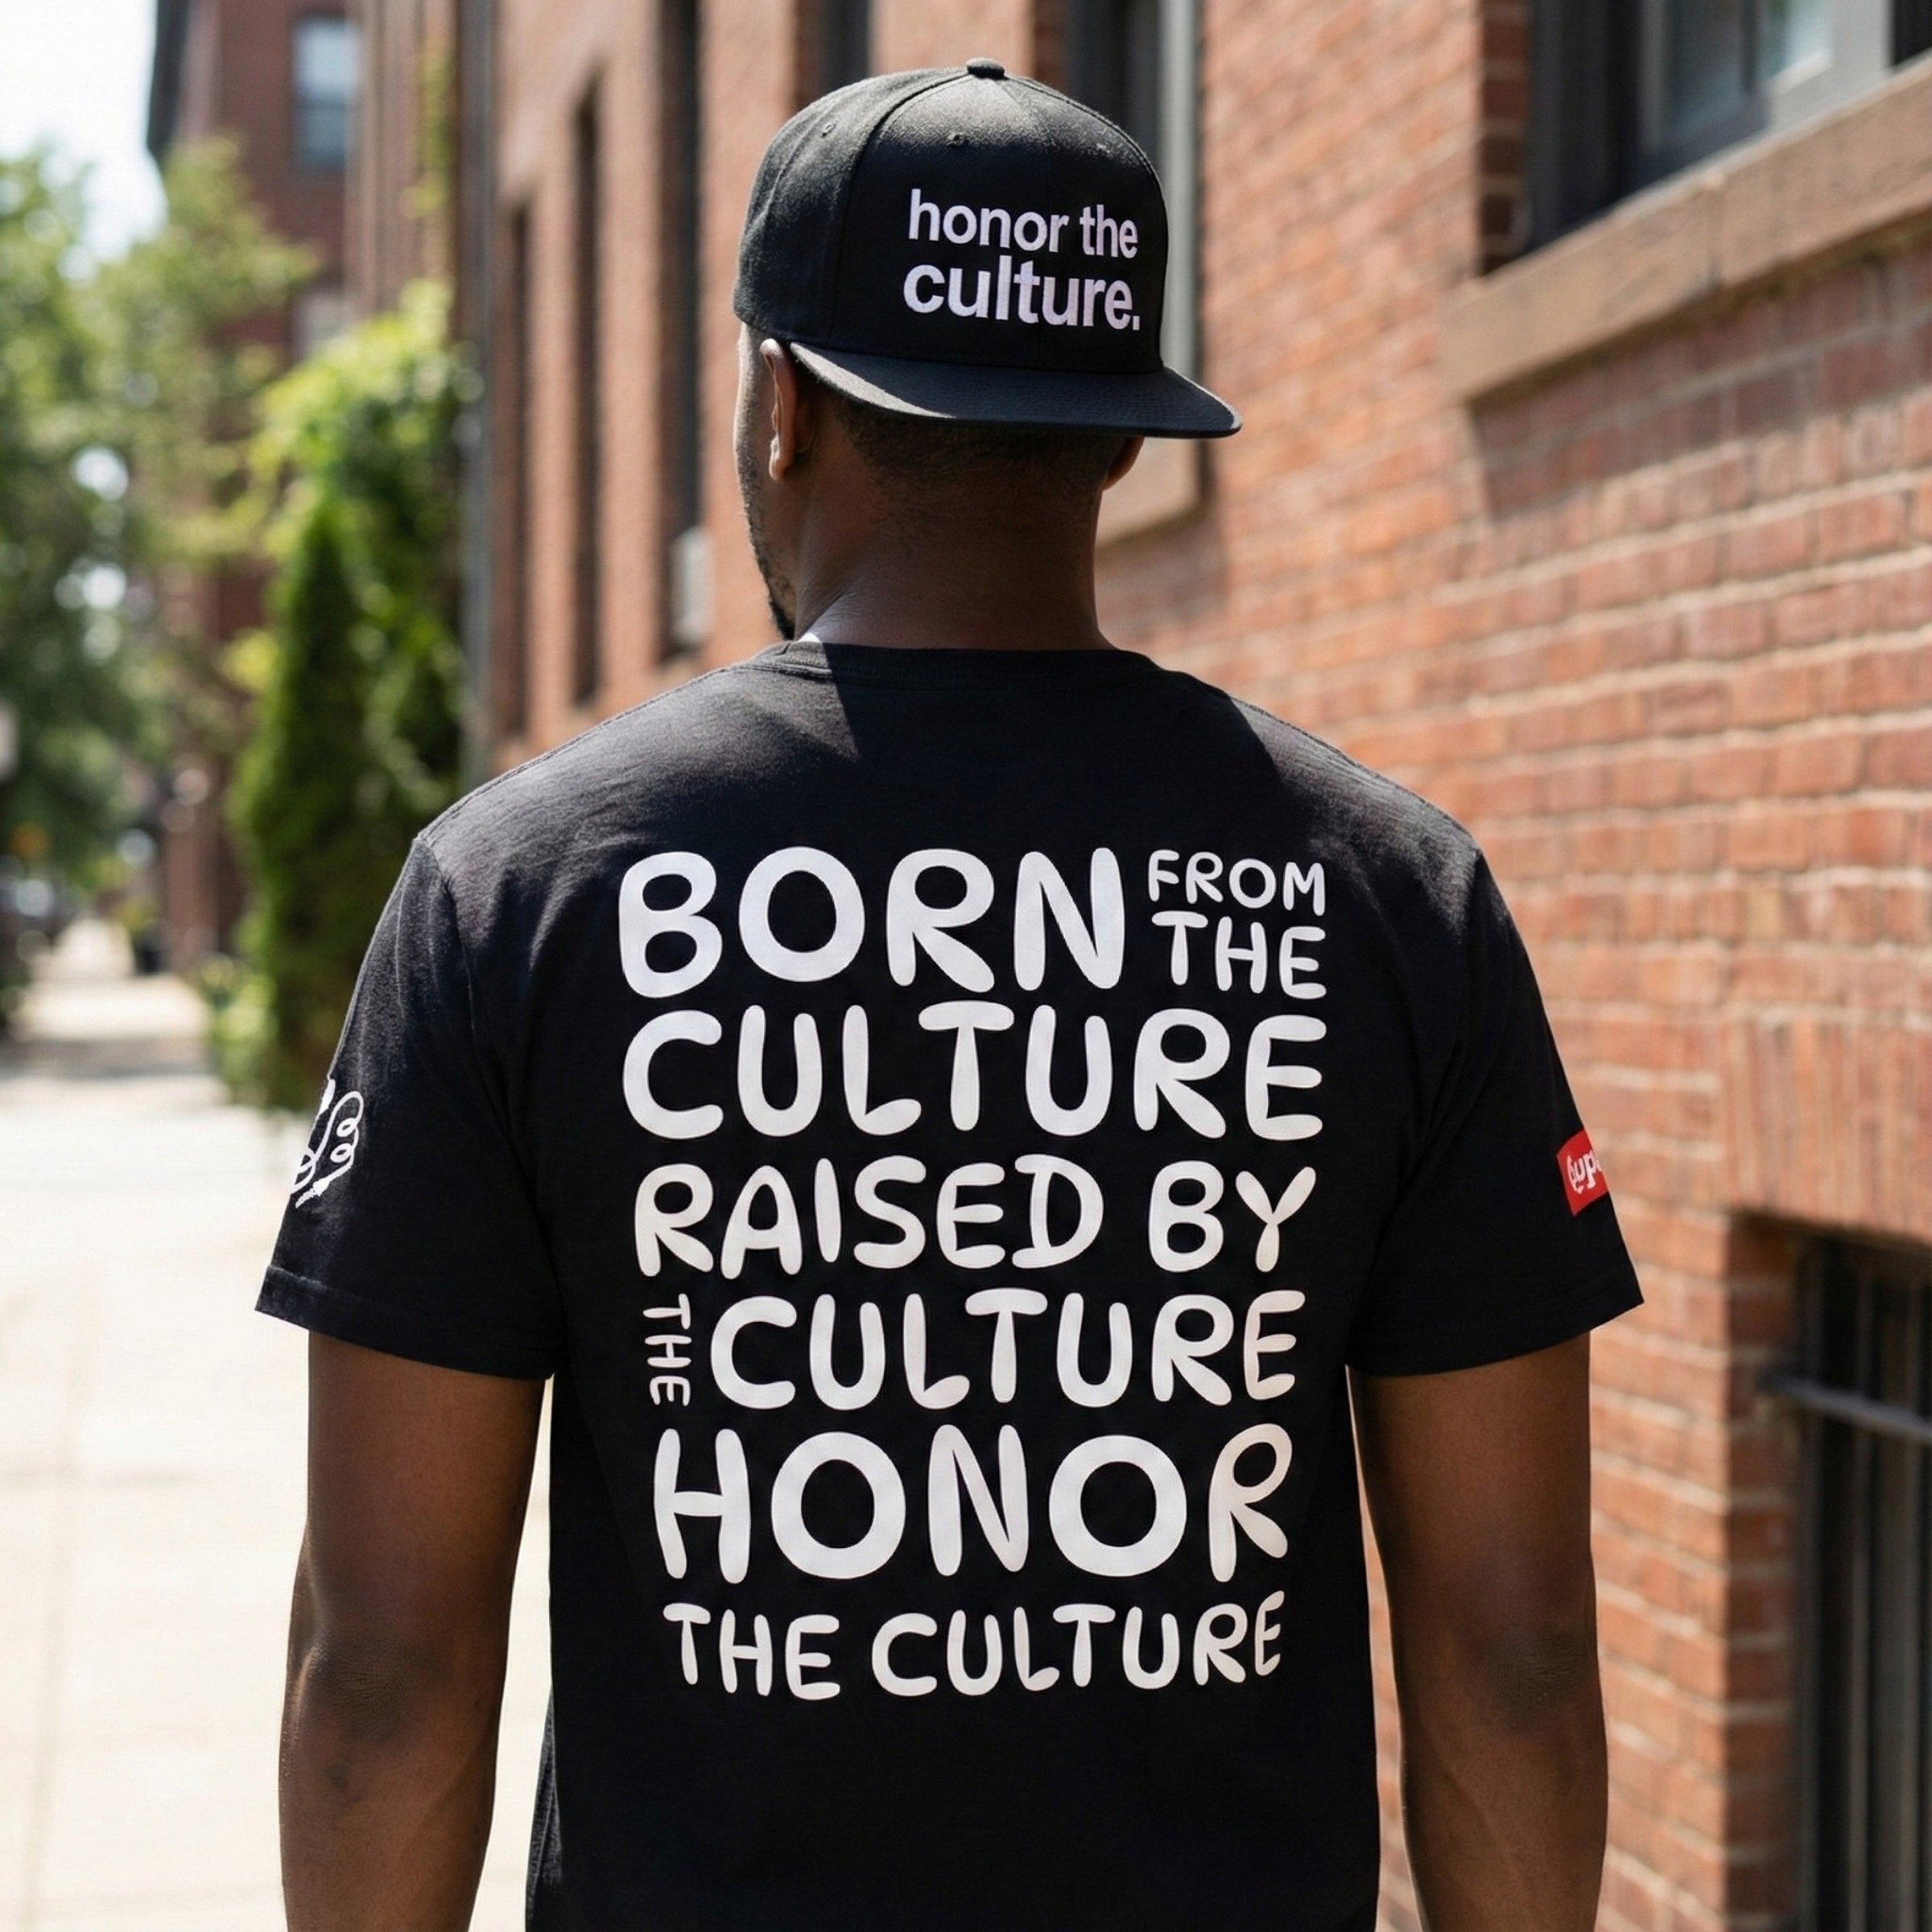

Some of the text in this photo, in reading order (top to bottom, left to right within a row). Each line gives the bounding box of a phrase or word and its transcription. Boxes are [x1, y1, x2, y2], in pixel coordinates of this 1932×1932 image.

[909, 188, 1137, 258] honor the
[903, 254, 1140, 330] culture.
[618, 847, 1125, 998] BORN
[1148, 849, 1325, 916] FROM
[1151, 910, 1327, 1000] THE
[622, 1000, 1327, 1141] CULTURE
[634, 1154, 1316, 1280] RAISED BY
[642, 1287, 1306, 1411] THE CULTURE
[654, 1423, 1292, 1584] HONOR
[663, 1590, 1285, 1700] THE CULTURE
